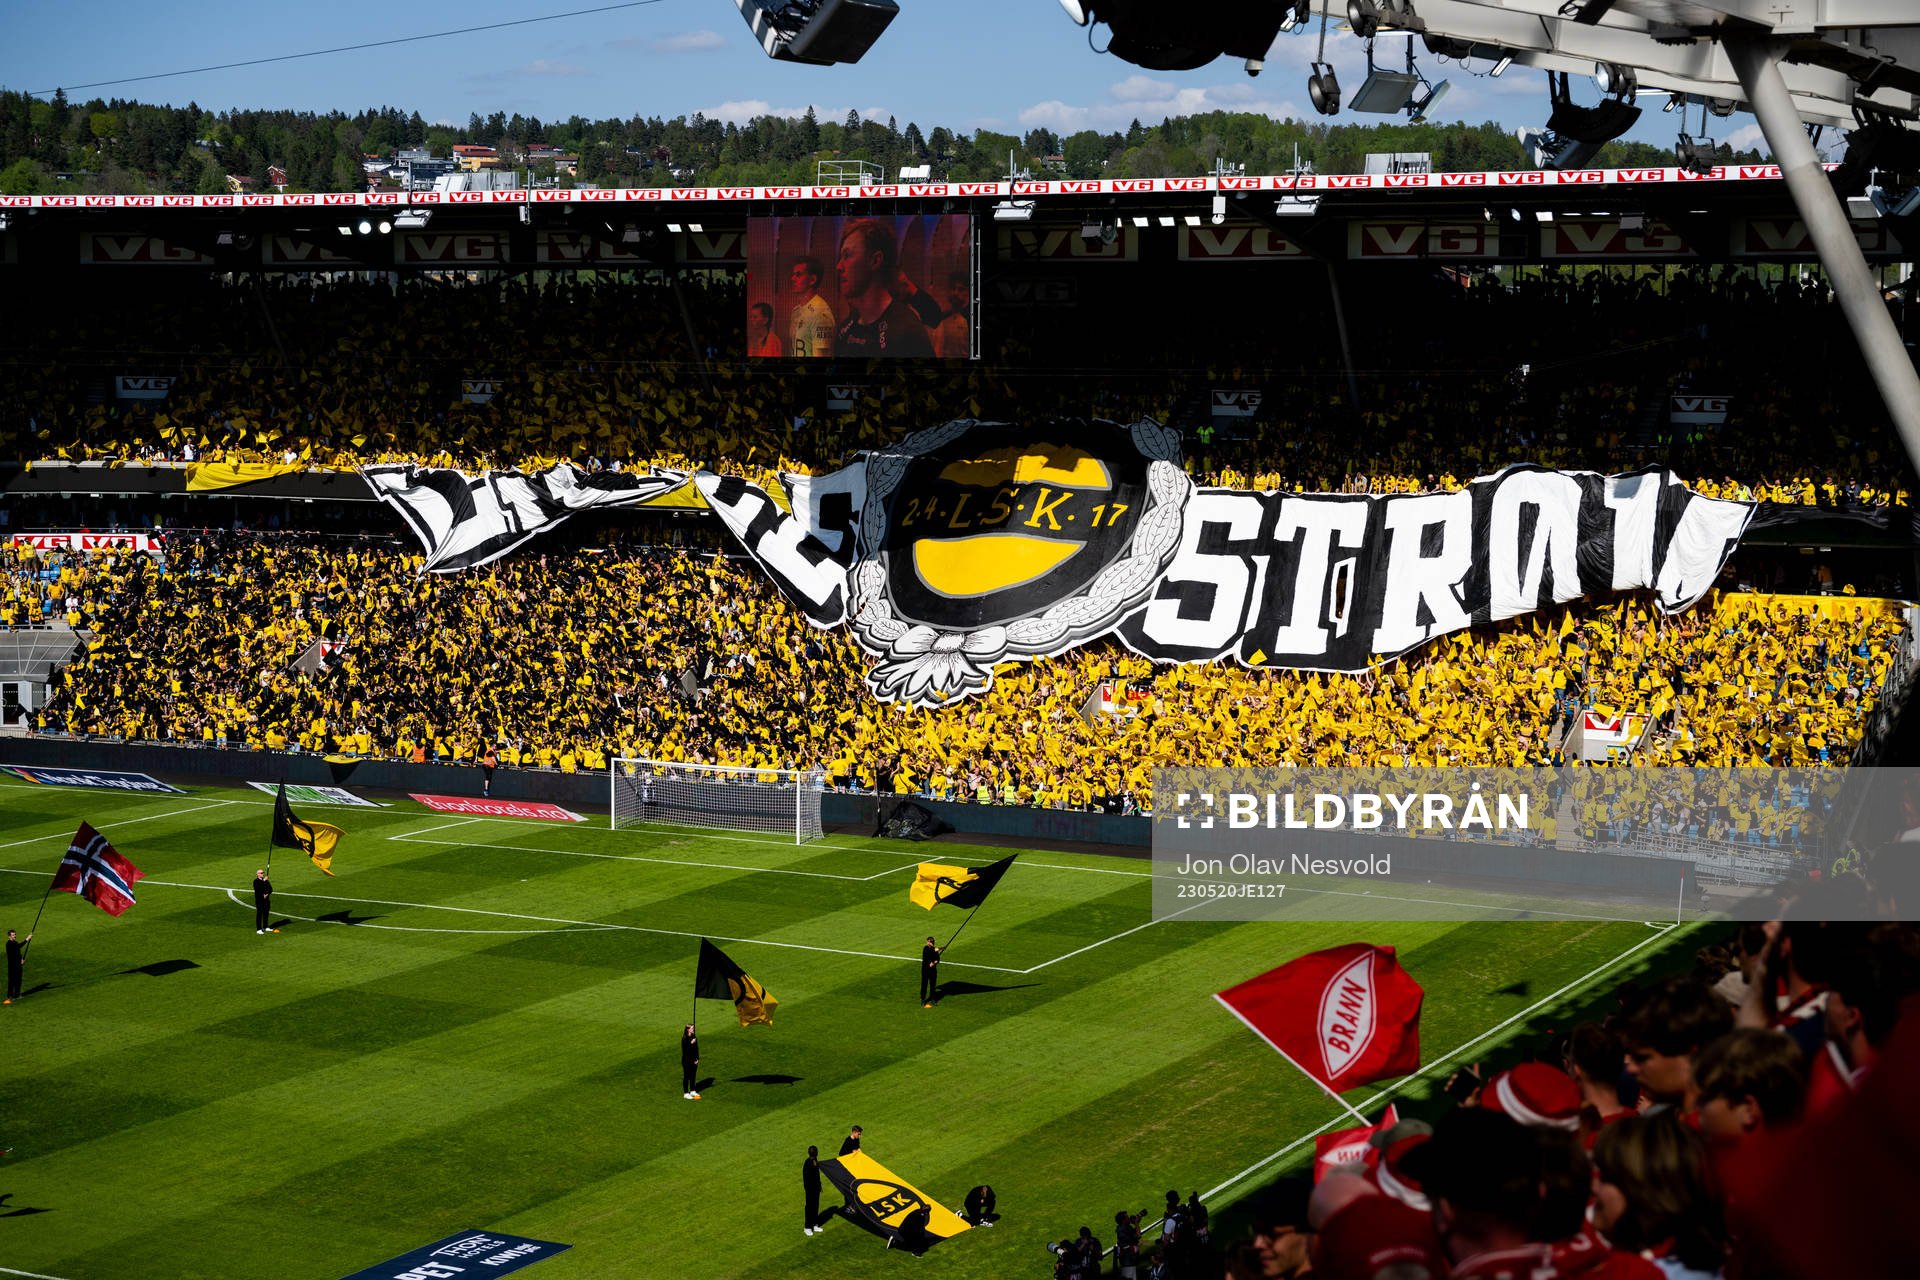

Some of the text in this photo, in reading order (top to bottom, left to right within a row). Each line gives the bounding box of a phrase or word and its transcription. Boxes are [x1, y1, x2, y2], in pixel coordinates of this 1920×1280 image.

[0, 197, 30, 206] VG
[43, 197, 75, 206] VG
[87, 197, 114, 206] VG
[125, 197, 153, 206] VG
[164, 197, 192, 206] VG
[204, 197, 232, 206] VG
[244, 196, 272, 205] VG
[285, 195, 313, 204] VG
[325, 194, 354, 204] VG
[366, 194, 396, 204] VG
[411, 193, 439, 203] VG
[451, 192, 481, 202] VG
[494, 192, 525, 201] VG
[538, 191, 569, 201] VG
[582, 191, 614, 200] VG
[627, 190, 660, 200] VG
[673, 189, 706, 199] VG
[719, 189, 752, 199] VG
[766, 188, 800, 198] VG
[813, 187, 848, 197] VG
[861, 186, 897, 196] VG
[911, 185, 946, 196] VG
[960, 184, 997, 195] VG
[1014, 183, 1048, 193] VG
[1062, 181, 1099, 192] VG
[1114, 180, 1152, 191] VG
[1166, 179, 1205, 190] VG
[1219, 178, 1259, 189] VG
[1275, 177, 1314, 188] VG
[1329, 176, 1370, 187] VG
[1385, 175, 1427, 186] VG
[1442, 174, 1484, 185] VG
[1500, 172, 1542, 184] VG
[1559, 171, 1602, 183] VG
[1619, 170, 1663, 182] VG
[410, 236, 499, 259] VG
[692, 234, 747, 259] V
[1192, 229, 1301, 255] VG
[1366, 226, 1478, 253] VG
[125, 378, 169, 389] VG
[1674, 399, 1729, 411] VG
[1328, 977, 1367, 1055] BRANN
[869, 1192, 912, 1218] LSK
[429, 1234, 492, 1257] THON
[458, 1240, 506, 1259] HOTELS
[479, 1249, 528, 1266] KIWI
